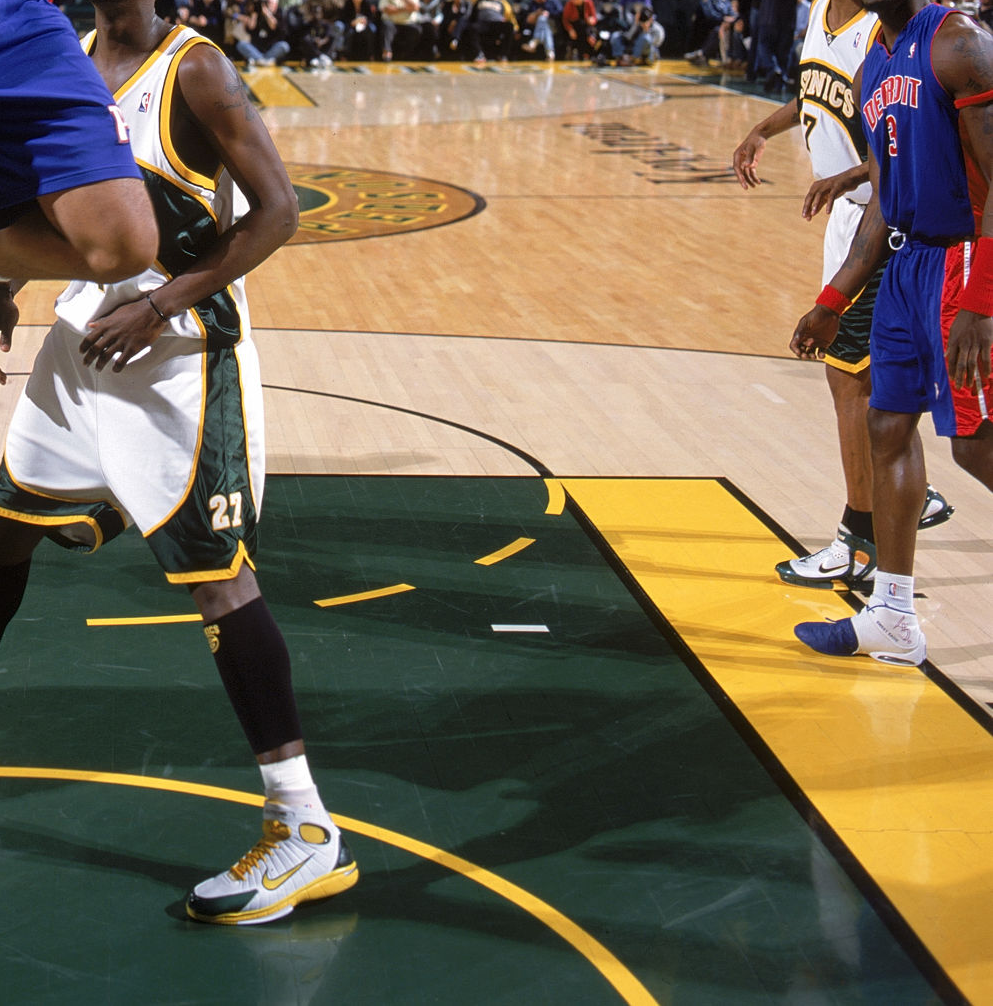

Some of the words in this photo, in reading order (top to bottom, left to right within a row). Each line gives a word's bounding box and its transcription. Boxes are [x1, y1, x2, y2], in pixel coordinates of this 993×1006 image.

[803, 111, 817, 153] 7
[885, 114, 898, 157] 3
[208, 490, 243, 532] 27
